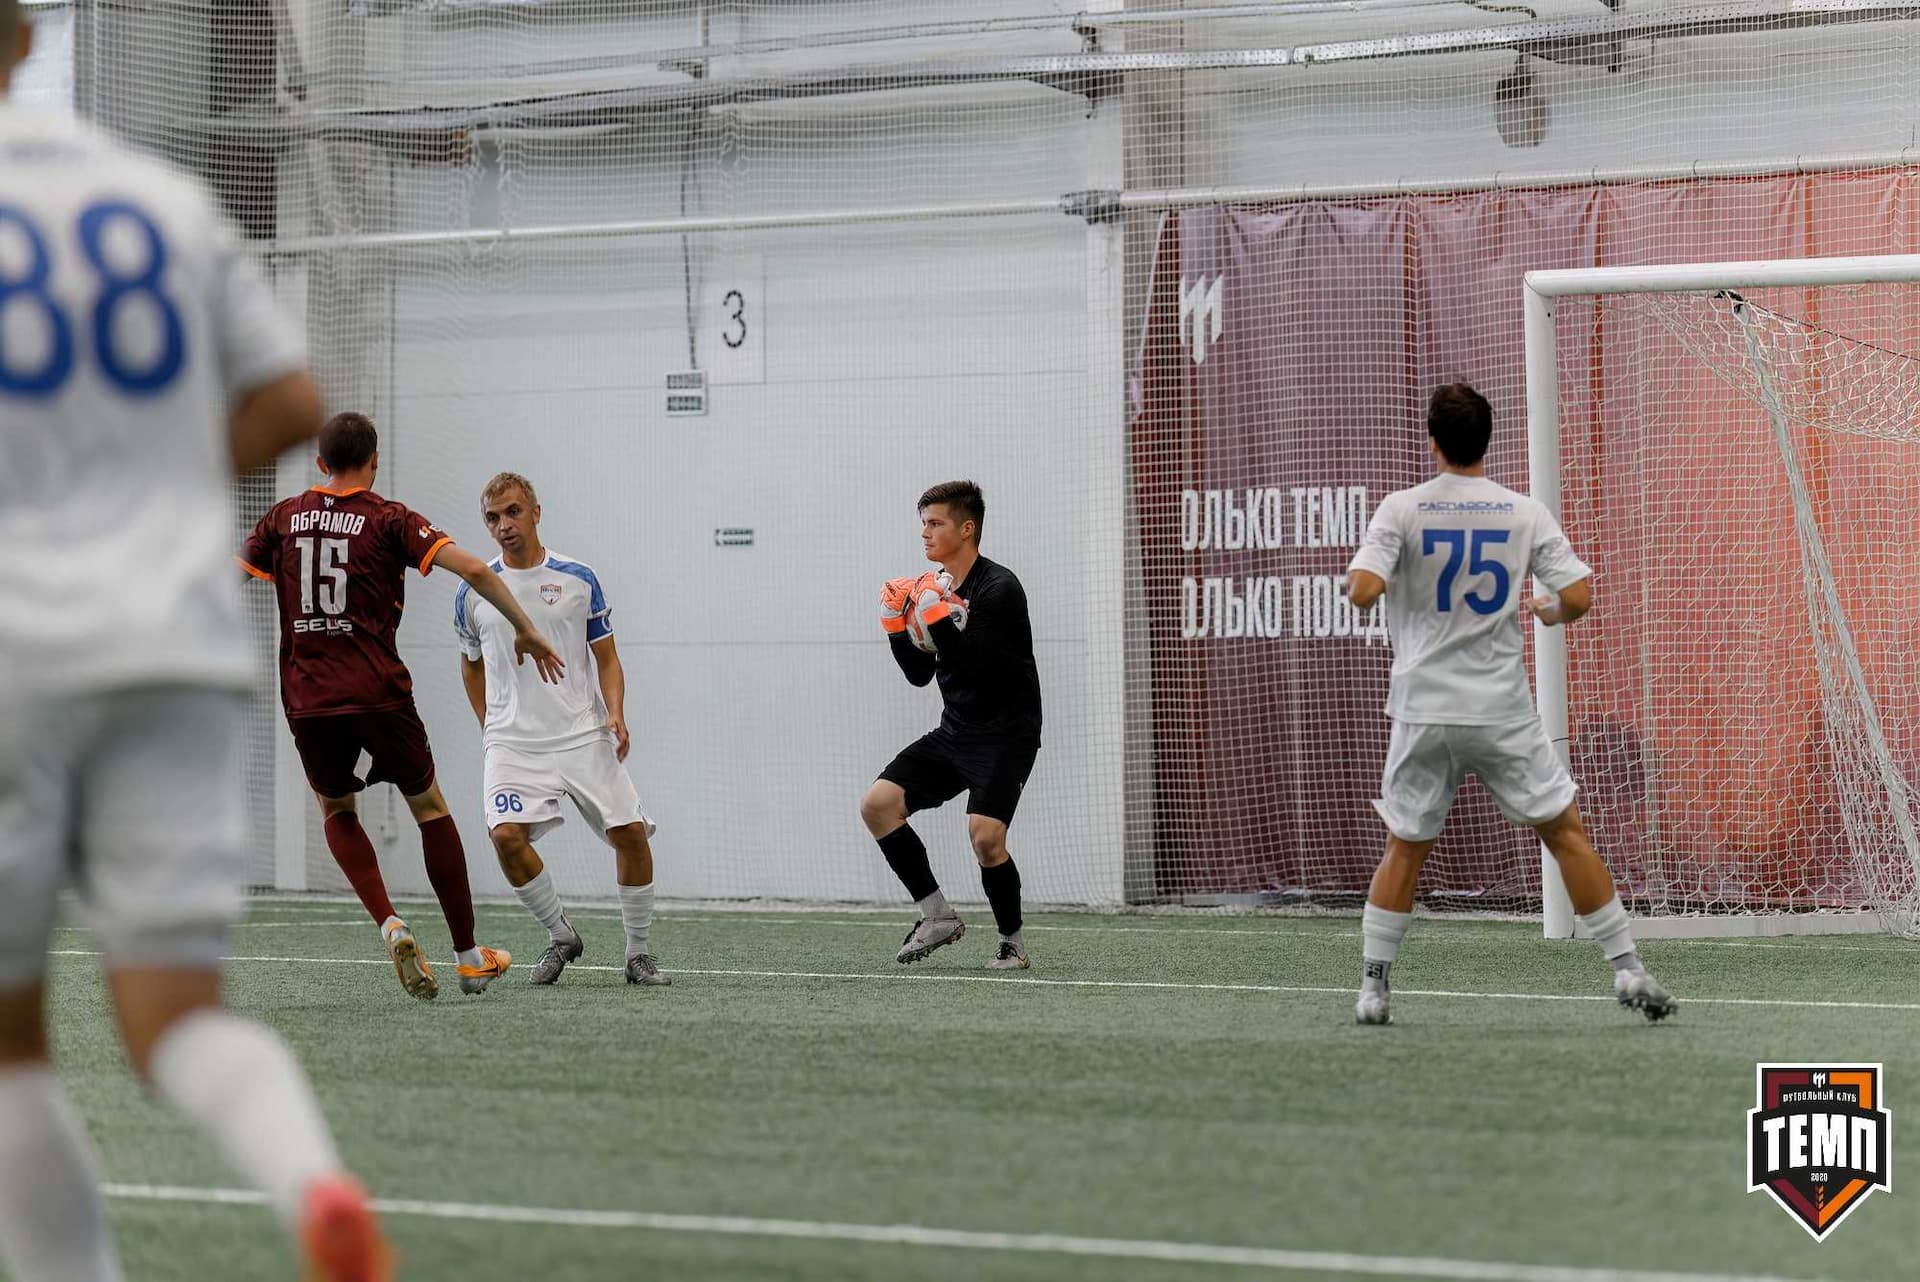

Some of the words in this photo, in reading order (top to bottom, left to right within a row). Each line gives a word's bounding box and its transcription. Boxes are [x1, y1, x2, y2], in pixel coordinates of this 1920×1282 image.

[0, 195, 186, 399] 88
[722, 289, 747, 349] 3
[290, 510, 365, 535] АБРАМОВ
[1292, 485, 1367, 549] ТЕМП
[295, 537, 349, 614] 15
[1422, 529, 1512, 616] 75
[494, 792, 524, 814] 96
